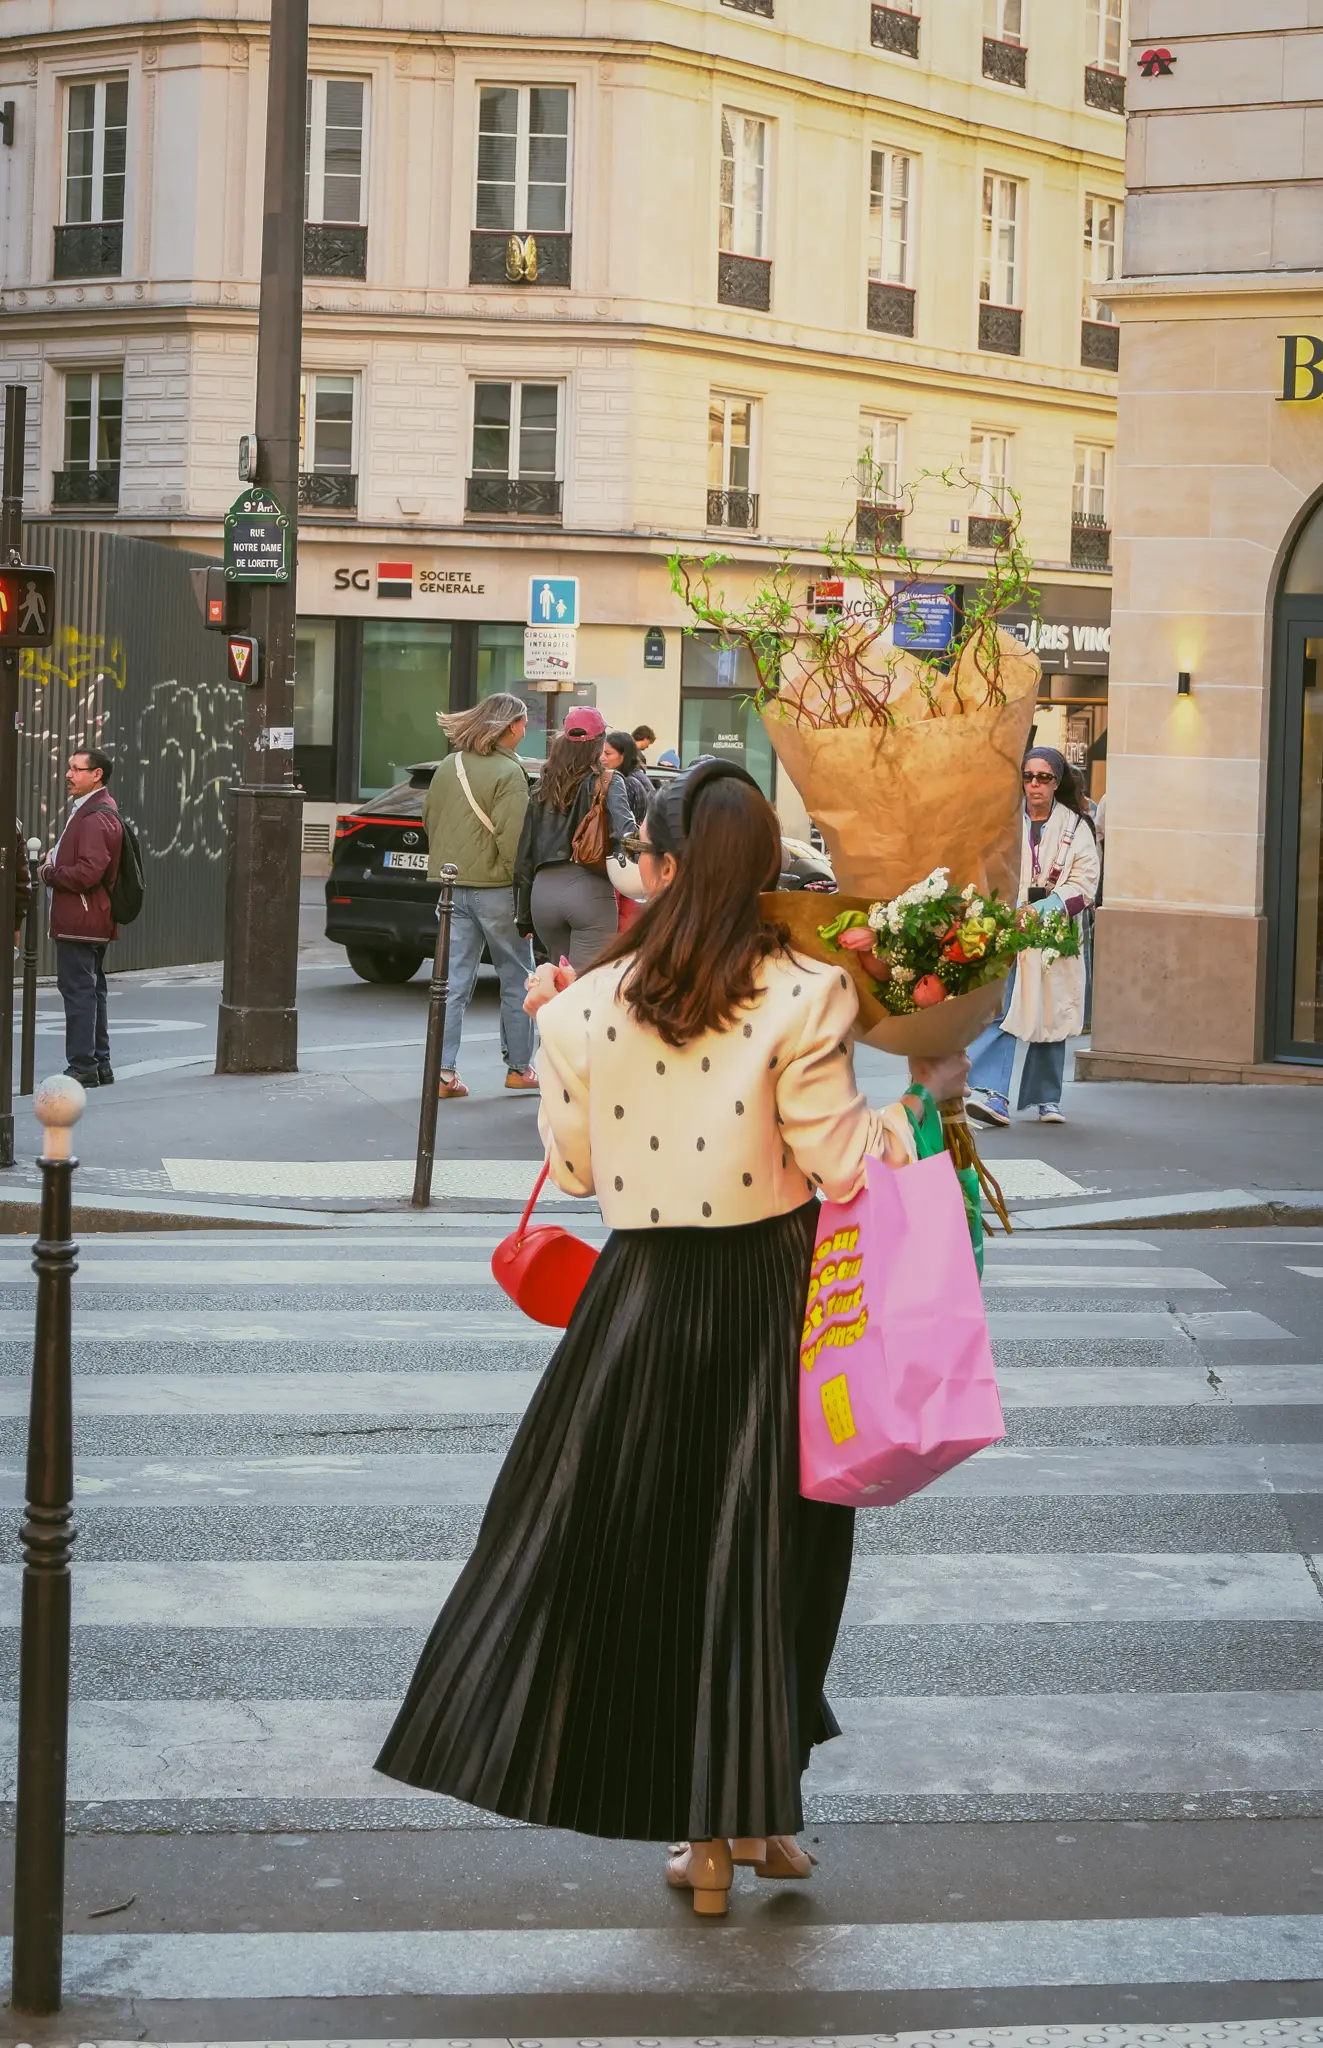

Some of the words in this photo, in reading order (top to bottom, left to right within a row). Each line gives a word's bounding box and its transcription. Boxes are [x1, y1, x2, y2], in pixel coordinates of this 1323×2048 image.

[250, 528, 265, 537] RUE
[233, 543, 258, 552] NOTRE
[260, 543, 282, 552] DAME
[236, 559, 246, 568] DE
[247, 559, 278, 568] LORETTE
[334, 568, 370, 591] SG
[419, 570, 472, 582] SOCIETE
[419, 583, 485, 594] GENERALE
[525, 631, 575, 639] CIRCULATION
[718, 733, 739, 741] BANQUE
[712, 741, 744, 749] ASSURANCES
